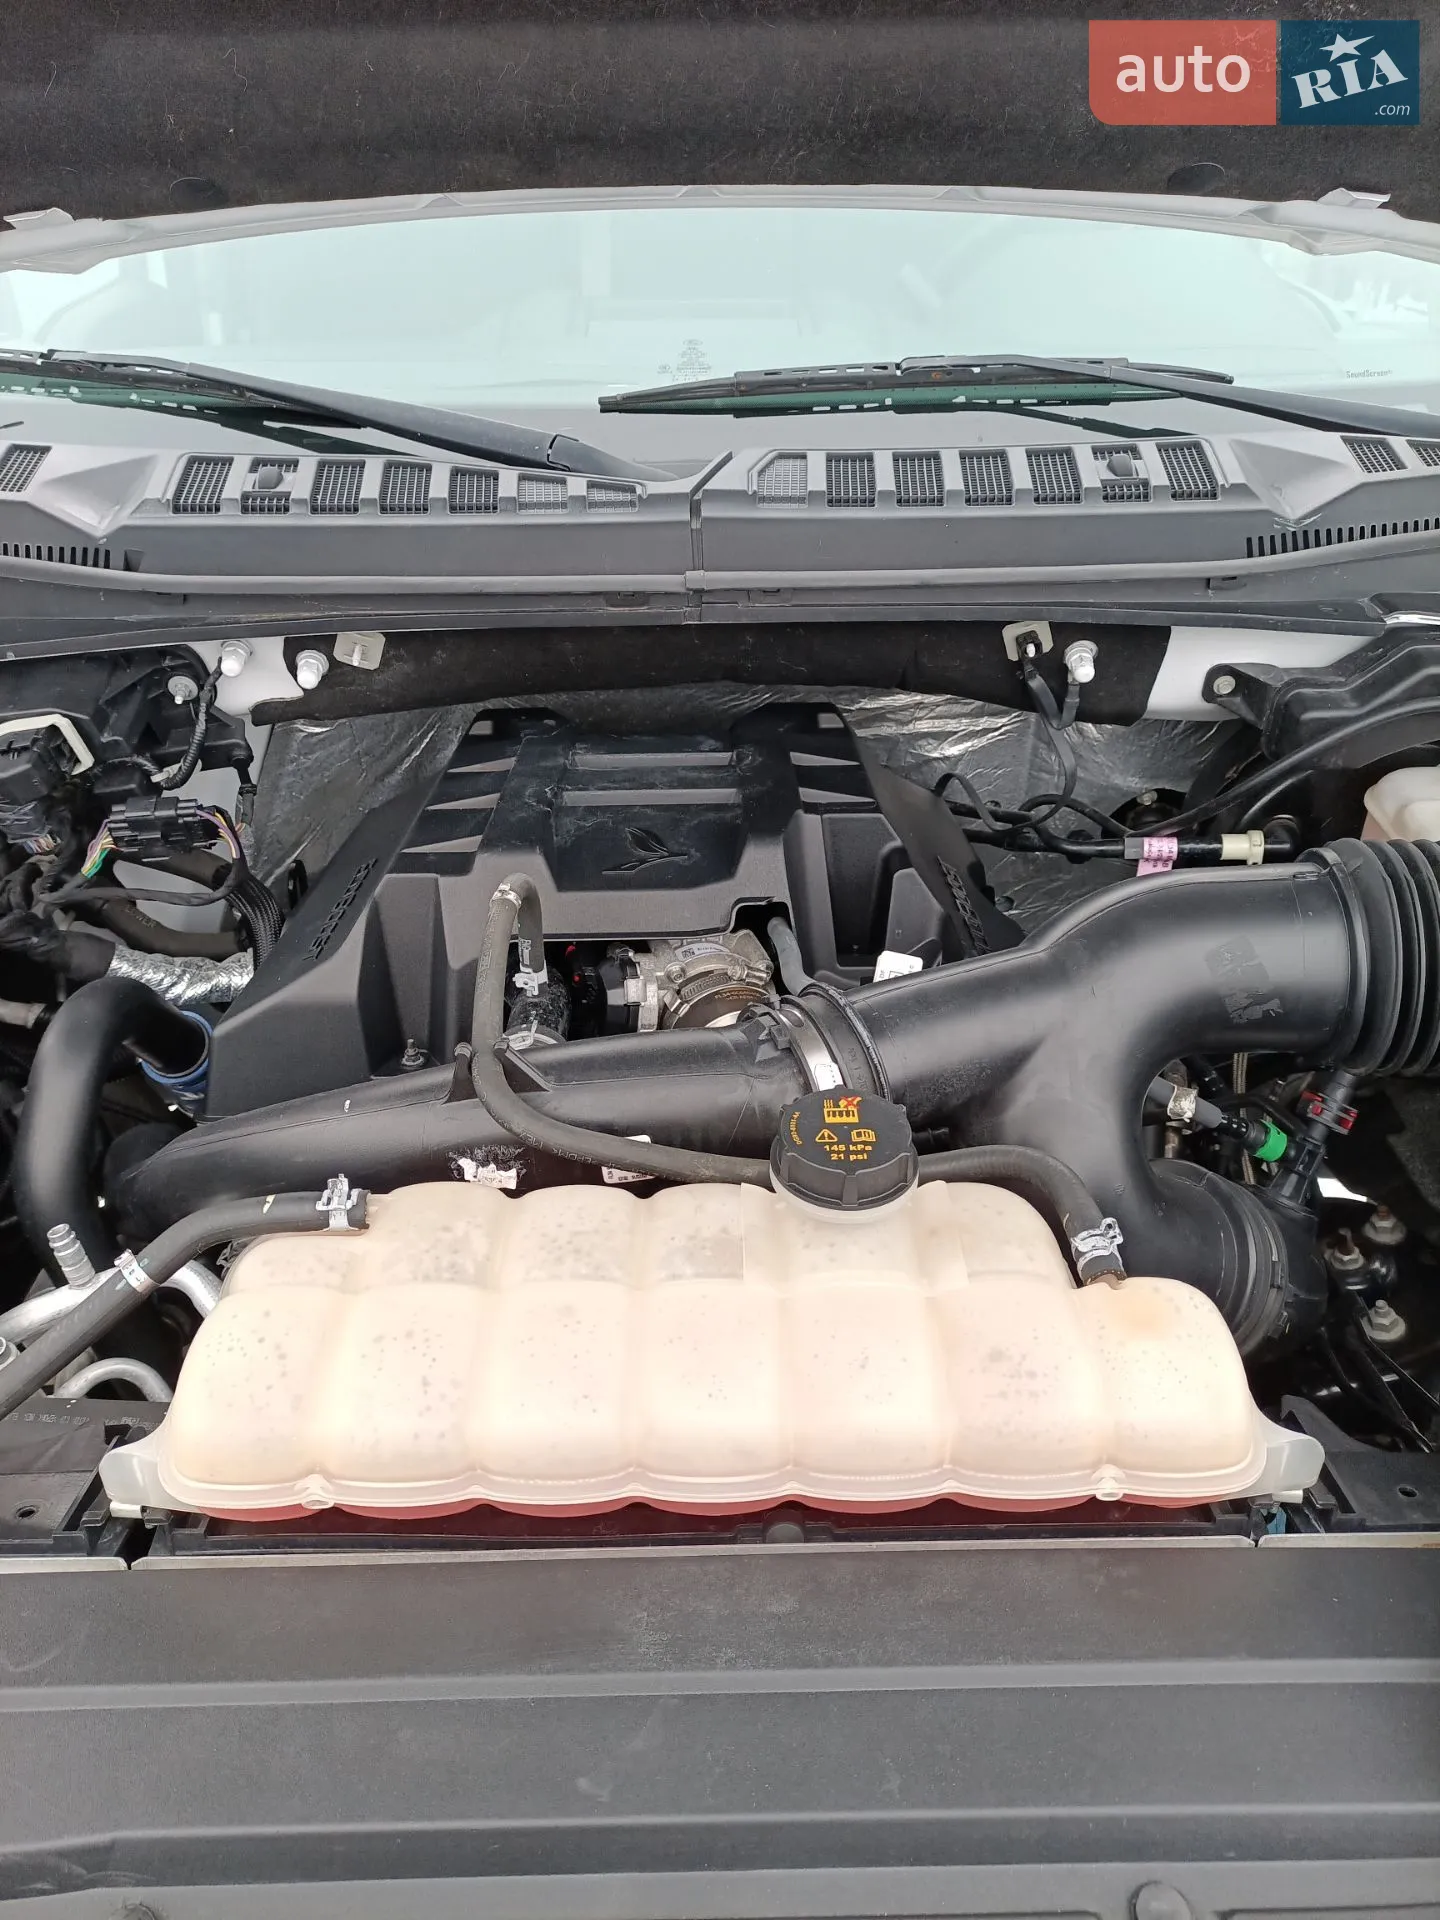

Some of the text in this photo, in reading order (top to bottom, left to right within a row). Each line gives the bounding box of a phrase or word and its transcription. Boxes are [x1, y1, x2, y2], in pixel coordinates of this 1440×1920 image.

[824, 1144, 873, 1152] 145 kPa
[830, 1153, 868, 1162] 21 psi
